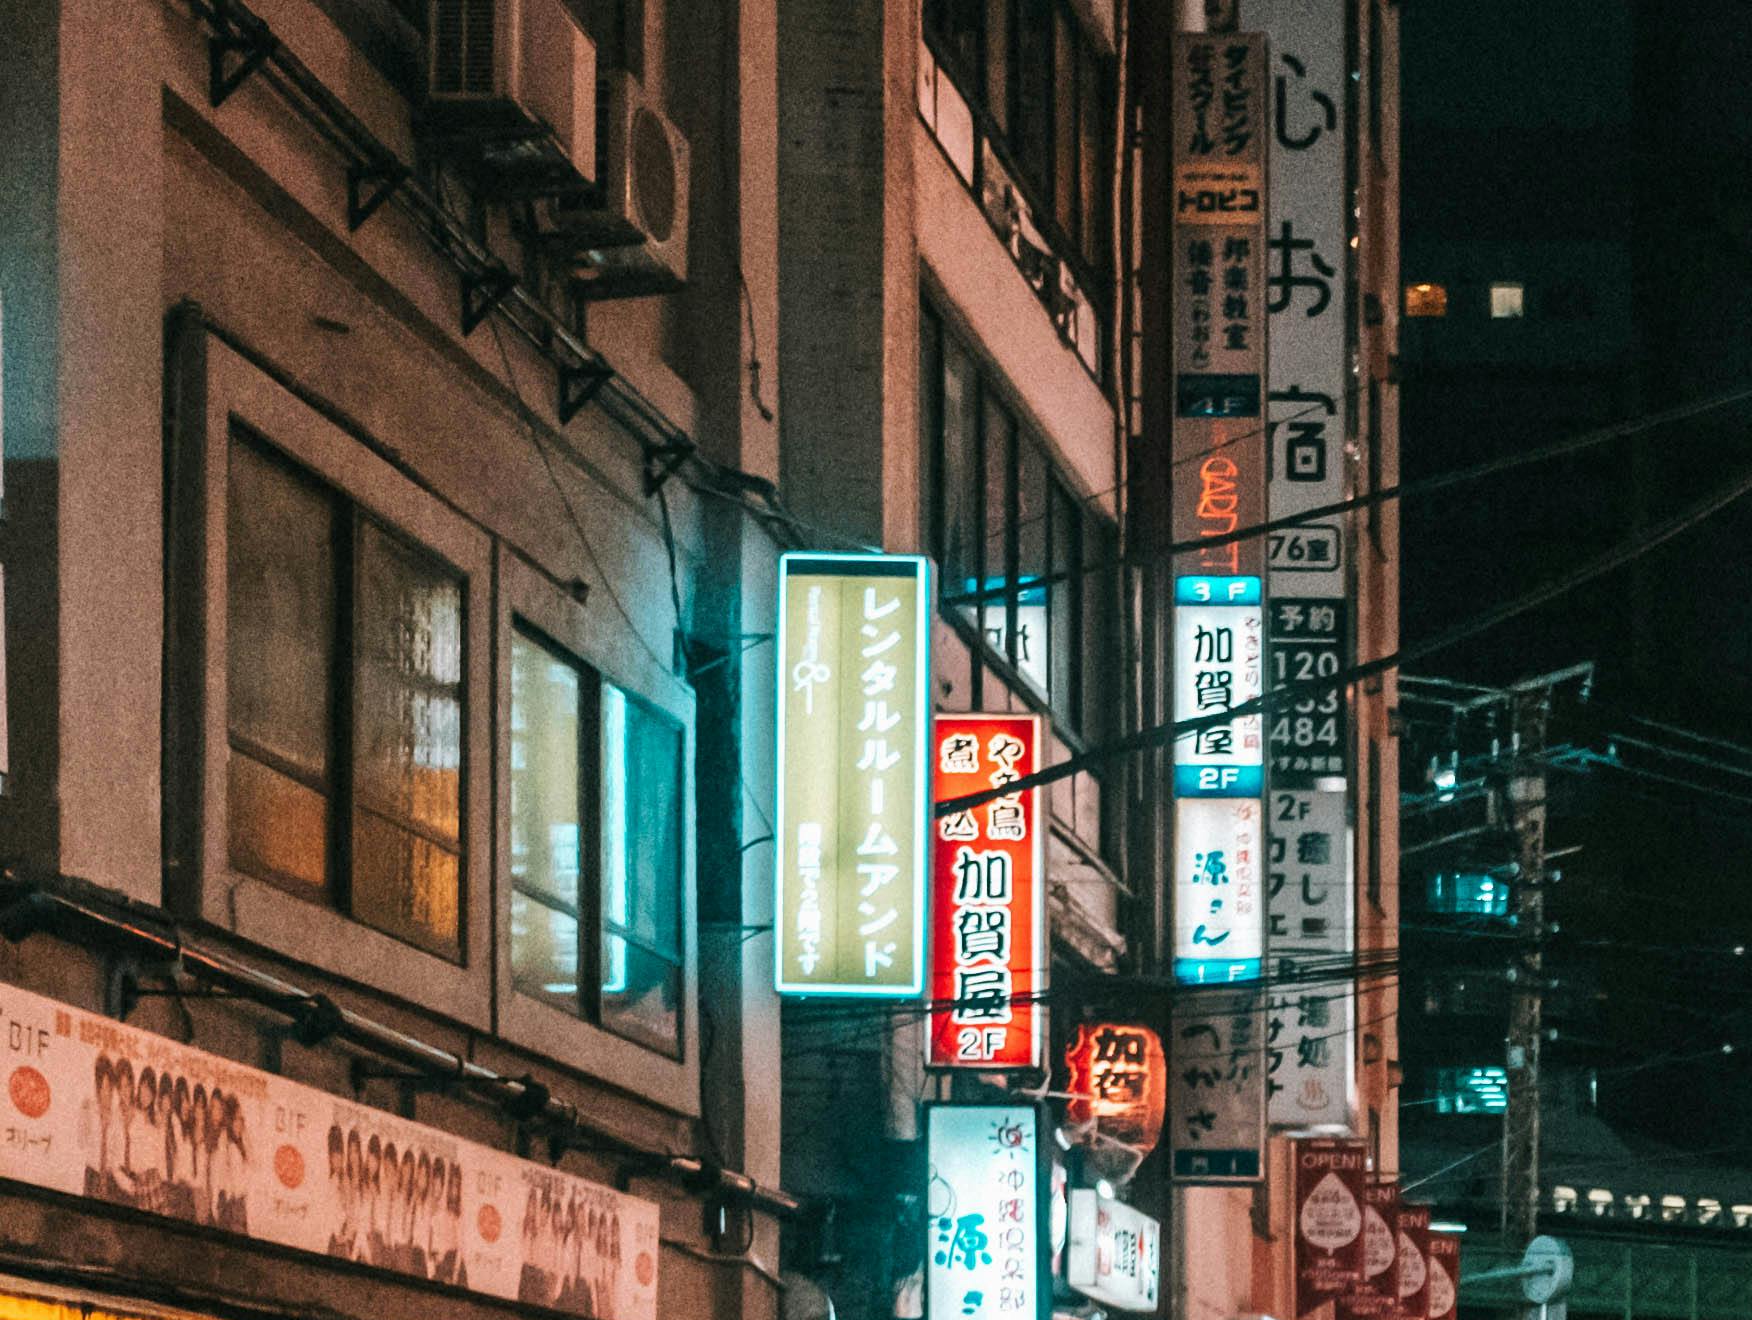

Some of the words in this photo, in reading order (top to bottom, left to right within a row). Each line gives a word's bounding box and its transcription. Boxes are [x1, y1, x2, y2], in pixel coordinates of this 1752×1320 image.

[1279, 605, 1335, 632] 予約
[1273, 651, 1339, 681] 120
[1193, 624, 1233, 755] 加賀屋
[1271, 717, 1339, 748] 484
[856, 585, 901, 978] レンタルルームアンド
[1200, 768, 1239, 789] 2F
[1277, 795, 1311, 821] 2F
[957, 850, 1008, 1019] 加賀屋
[961, 1032, 1004, 1059] 2F
[1303, 1153, 1363, 1169] OPEN!
[1365, 1186, 1396, 1201] EN!
[1398, 1212, 1429, 1228] EN!
[1430, 1240, 1459, 1254] EN!
